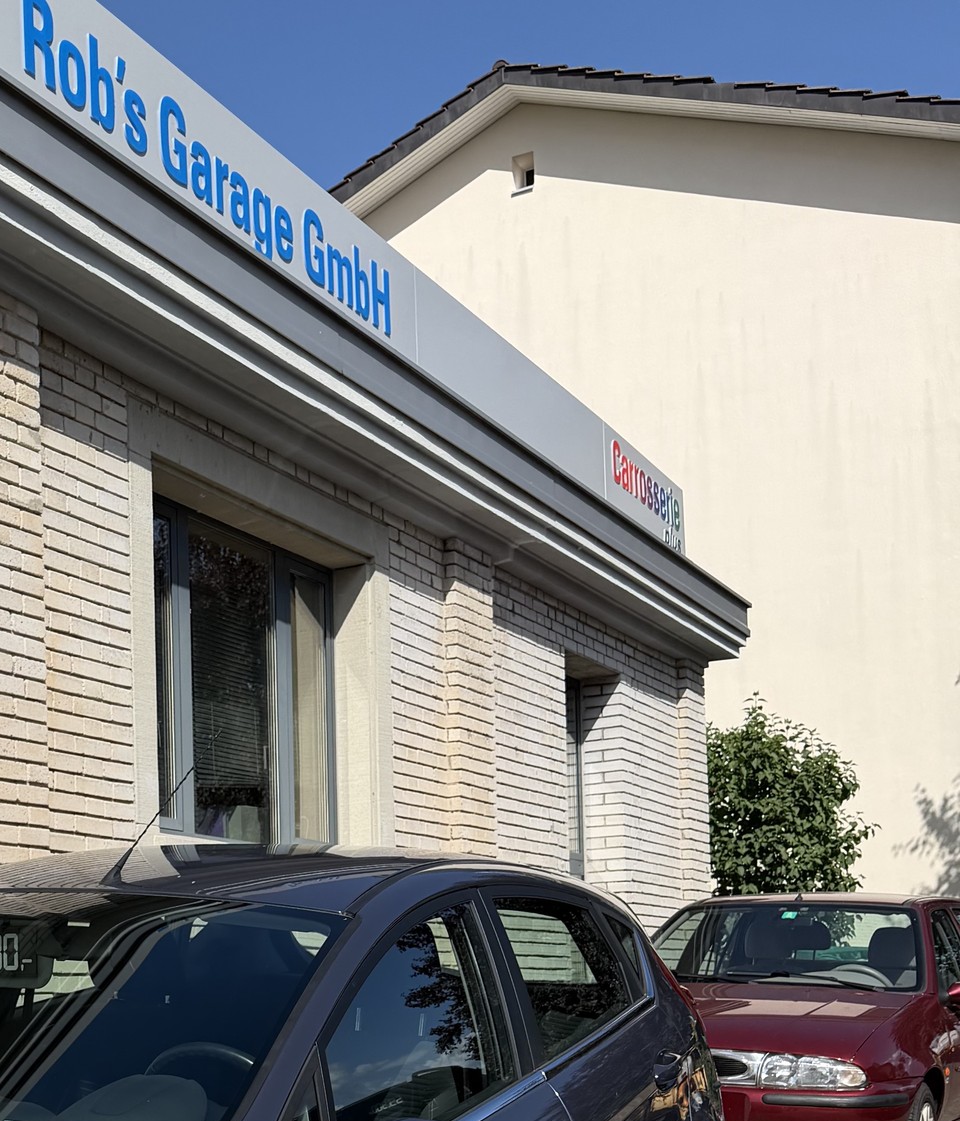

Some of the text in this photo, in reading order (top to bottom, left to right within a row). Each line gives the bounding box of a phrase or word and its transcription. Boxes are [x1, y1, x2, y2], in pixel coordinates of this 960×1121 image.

[21, 0, 392, 338] Rob's Garage GmbH
[611, 440, 680, 532] Carrosserie
